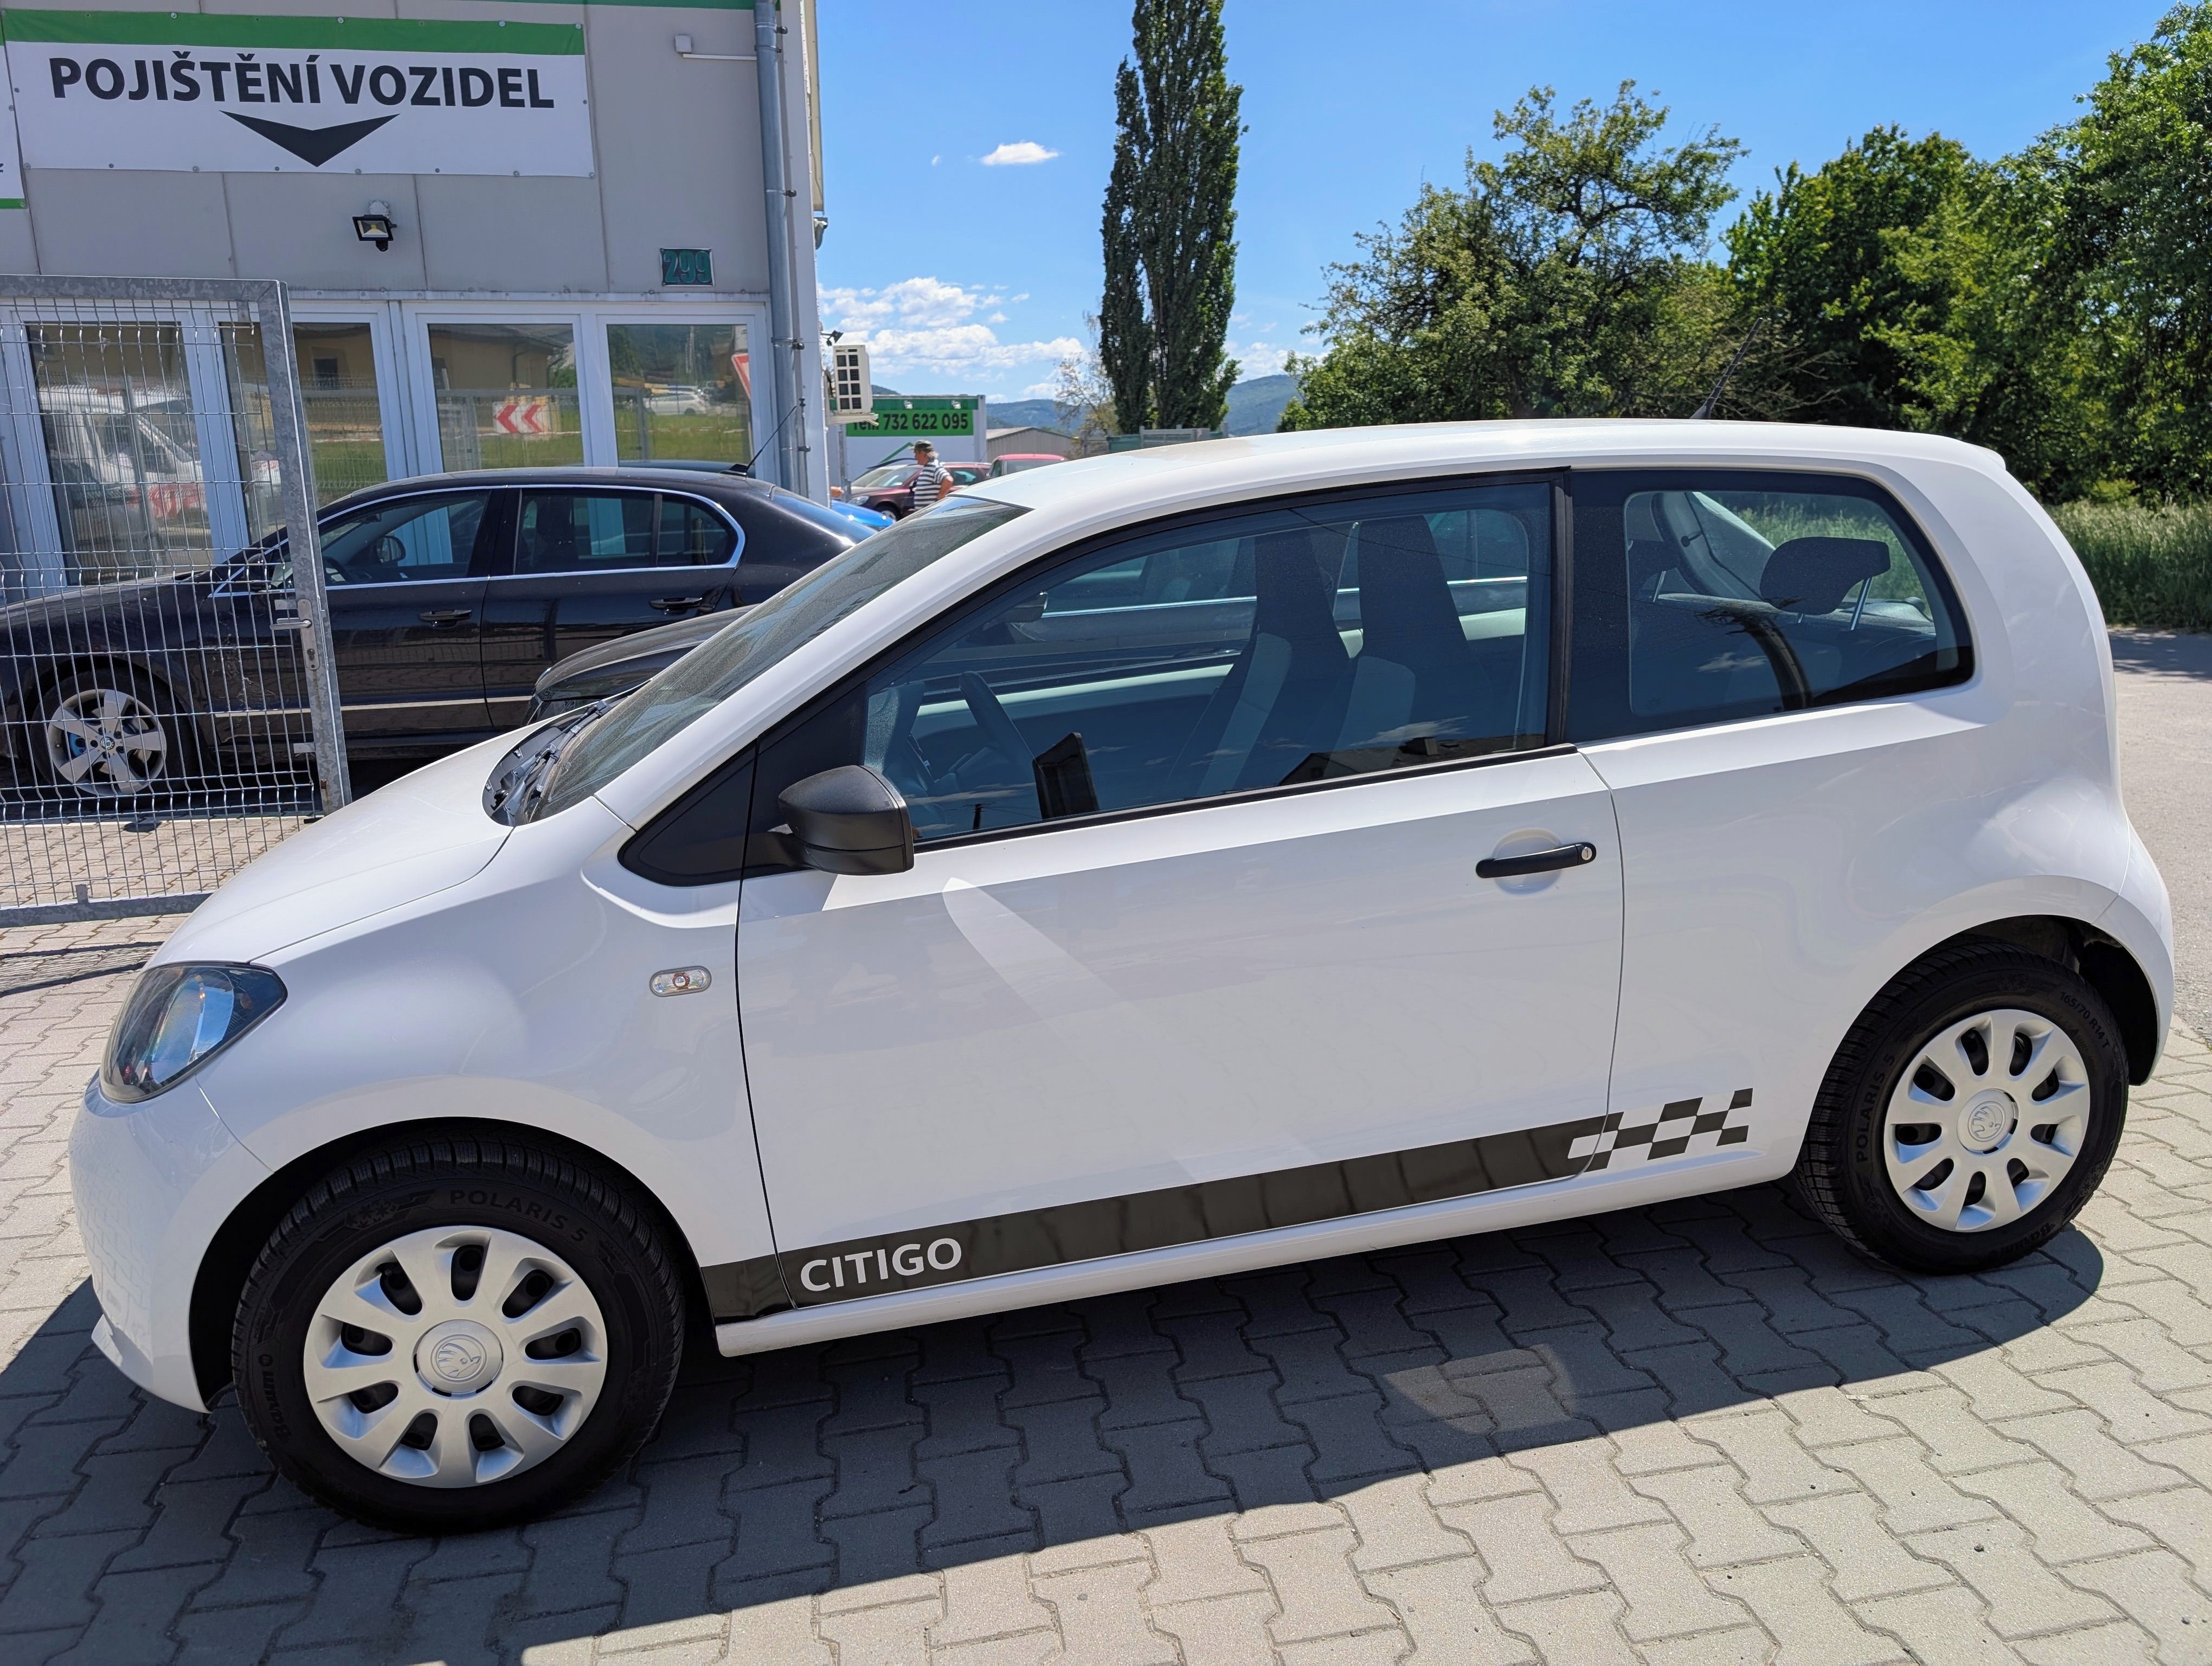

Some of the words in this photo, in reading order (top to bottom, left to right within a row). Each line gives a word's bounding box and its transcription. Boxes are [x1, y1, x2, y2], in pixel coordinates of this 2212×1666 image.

[49, 51, 321, 104] POJIŠTĚNÍ
[330, 64, 555, 108] VOZIDEL
[664, 251, 712, 283] 299
[883, 414, 908, 430] 732
[912, 413, 937, 430] 622
[942, 413, 968, 430] 095
[2060, 991, 2091, 1020] 165/70
[1856, 1071, 1885, 1162] POLARIS
[1882, 1053, 1895, 1066] 5
[449, 1190, 568, 1230] POLARIS
[570, 1227, 588, 1242] 5
[800, 1238, 962, 1291] CITIGO
